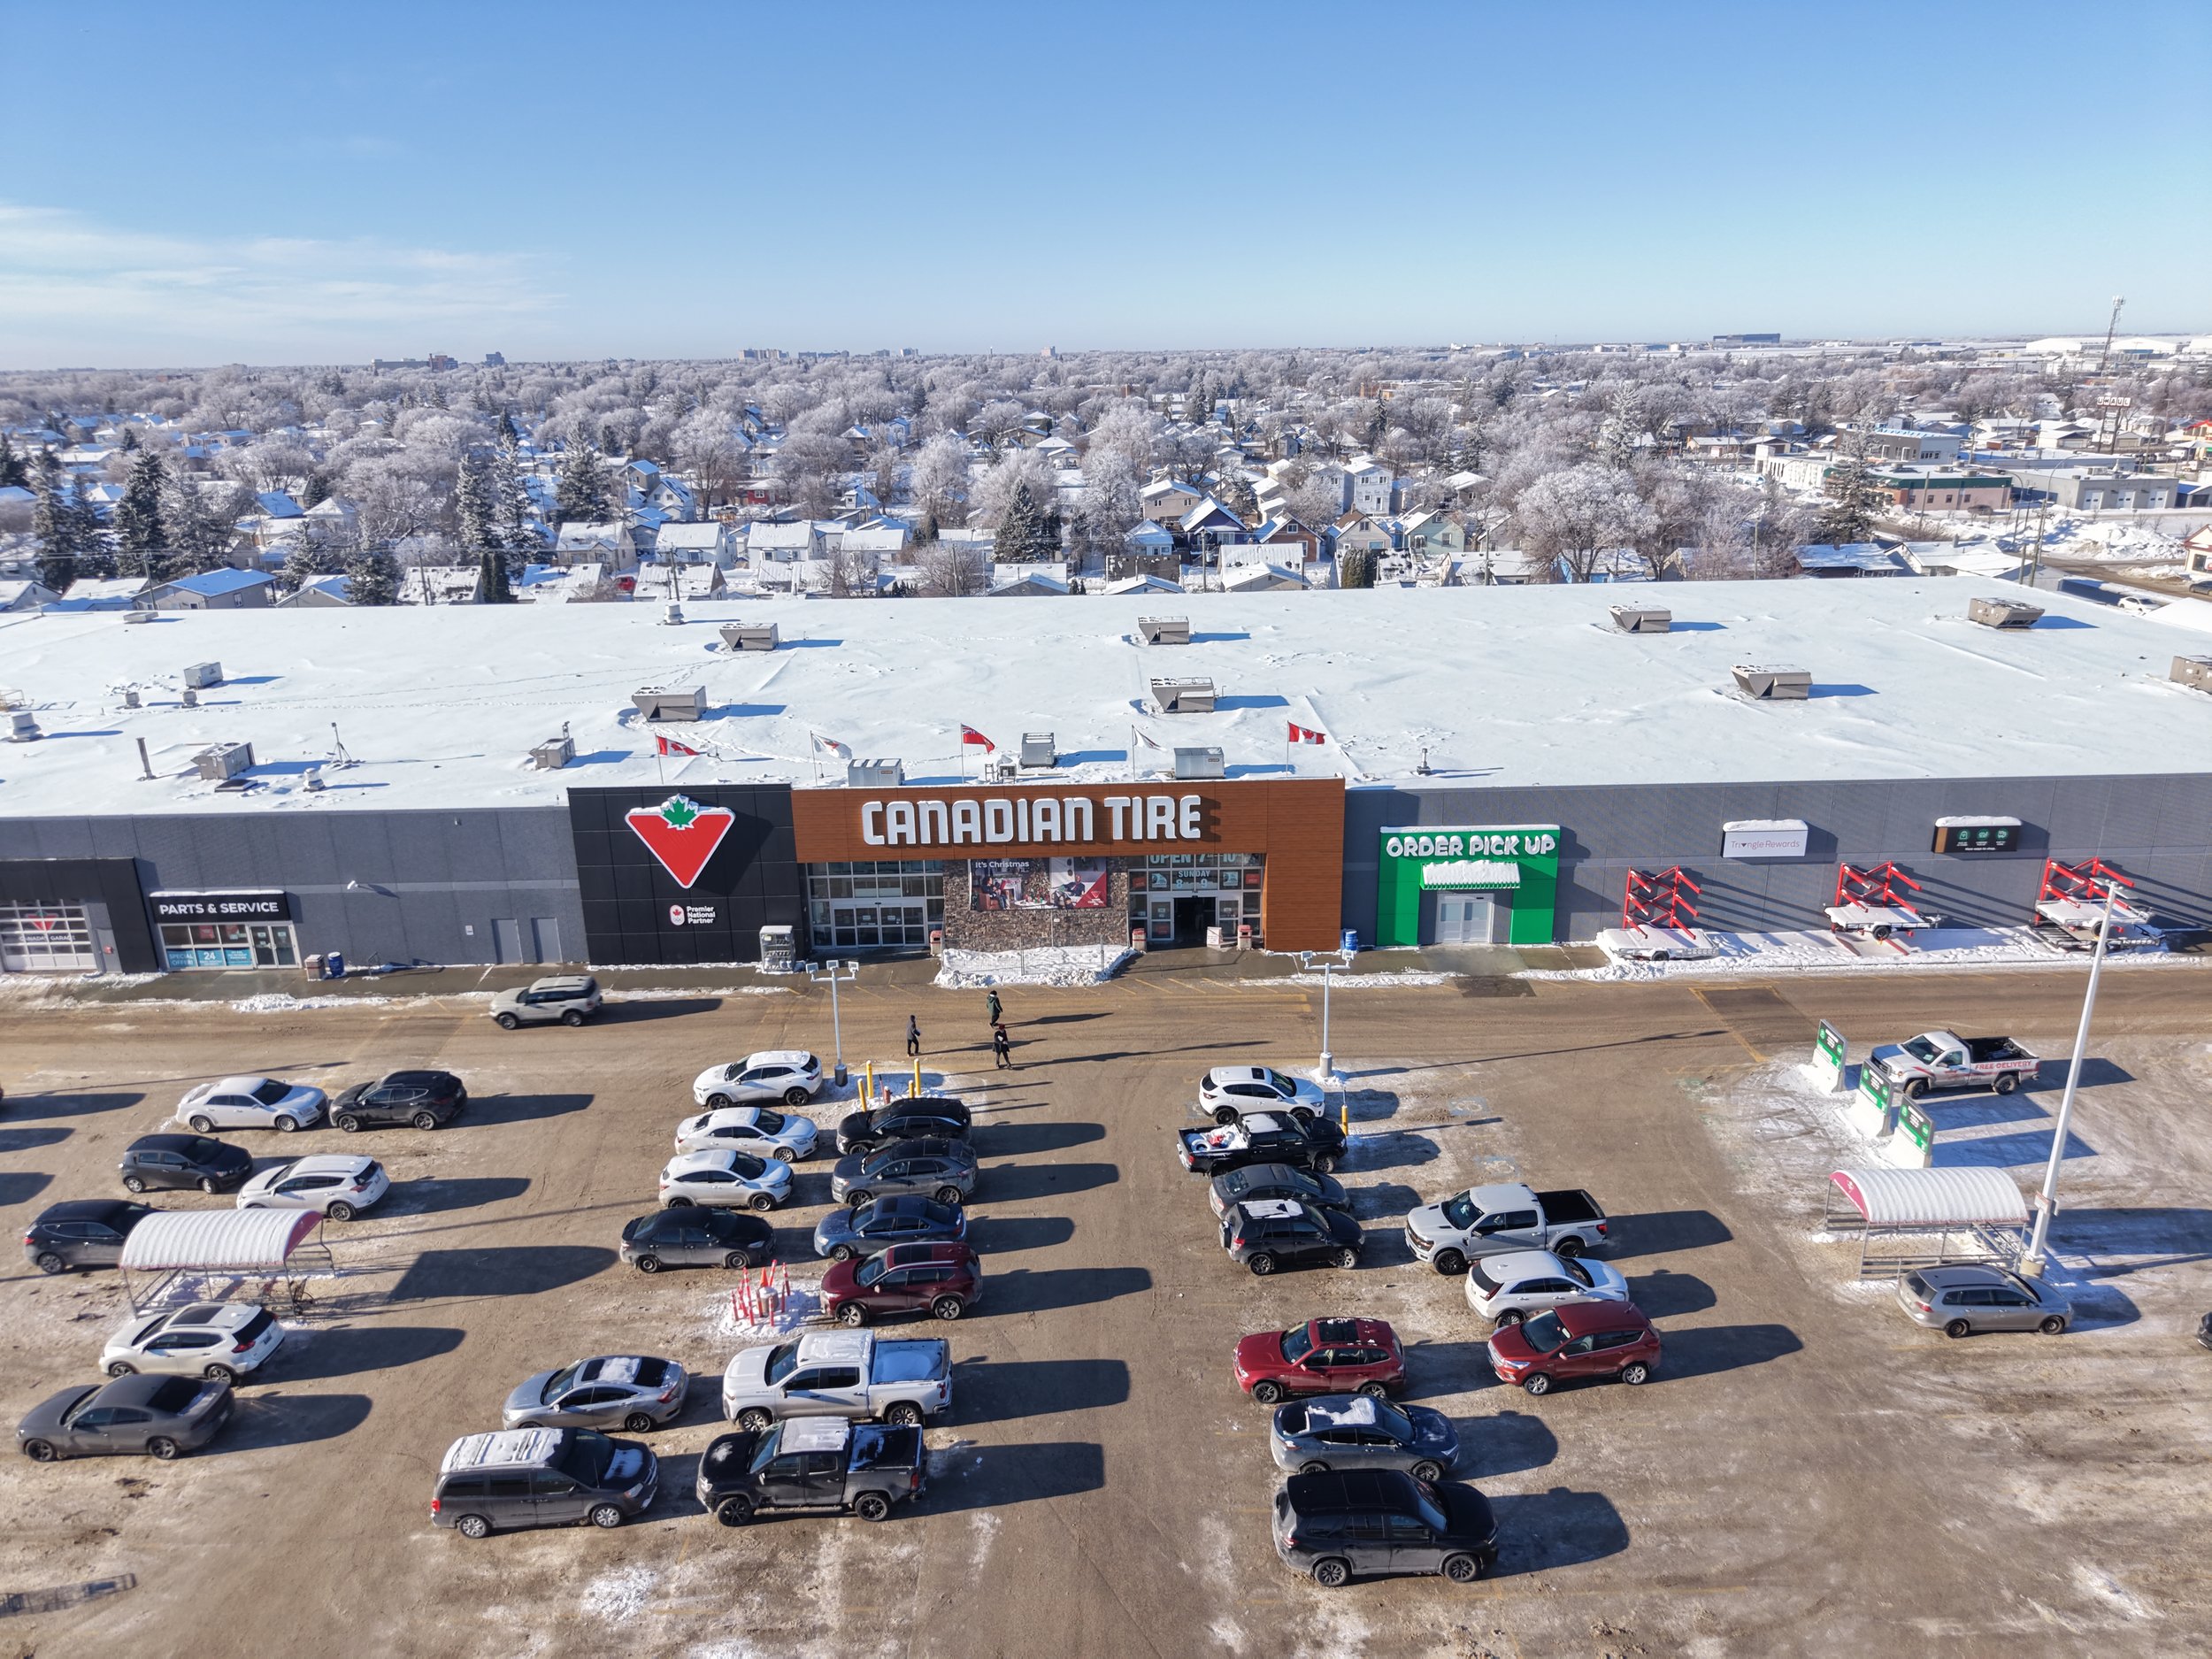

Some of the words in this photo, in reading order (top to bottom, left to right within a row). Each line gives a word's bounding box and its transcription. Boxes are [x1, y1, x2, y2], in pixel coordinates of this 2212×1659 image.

[862, 797, 1093, 845] CANADIAN
[1104, 795, 1202, 841] TIRE
[1386, 835, 1463, 856] ORDER
[1469, 834, 1519, 856] PICK
[1525, 834, 1555, 855] UP
[1150, 854, 1191, 864] OPEN
[1176, 879, 1183, 889] 8
[1200, 879, 1208, 888] 9
[159, 903, 204, 915] PARTS
[207, 902, 218, 914] &
[220, 902, 279, 913] SERVICE
[204, 951, 216, 960] 24
[1996, 1060, 2032, 1069] DELIVERY
